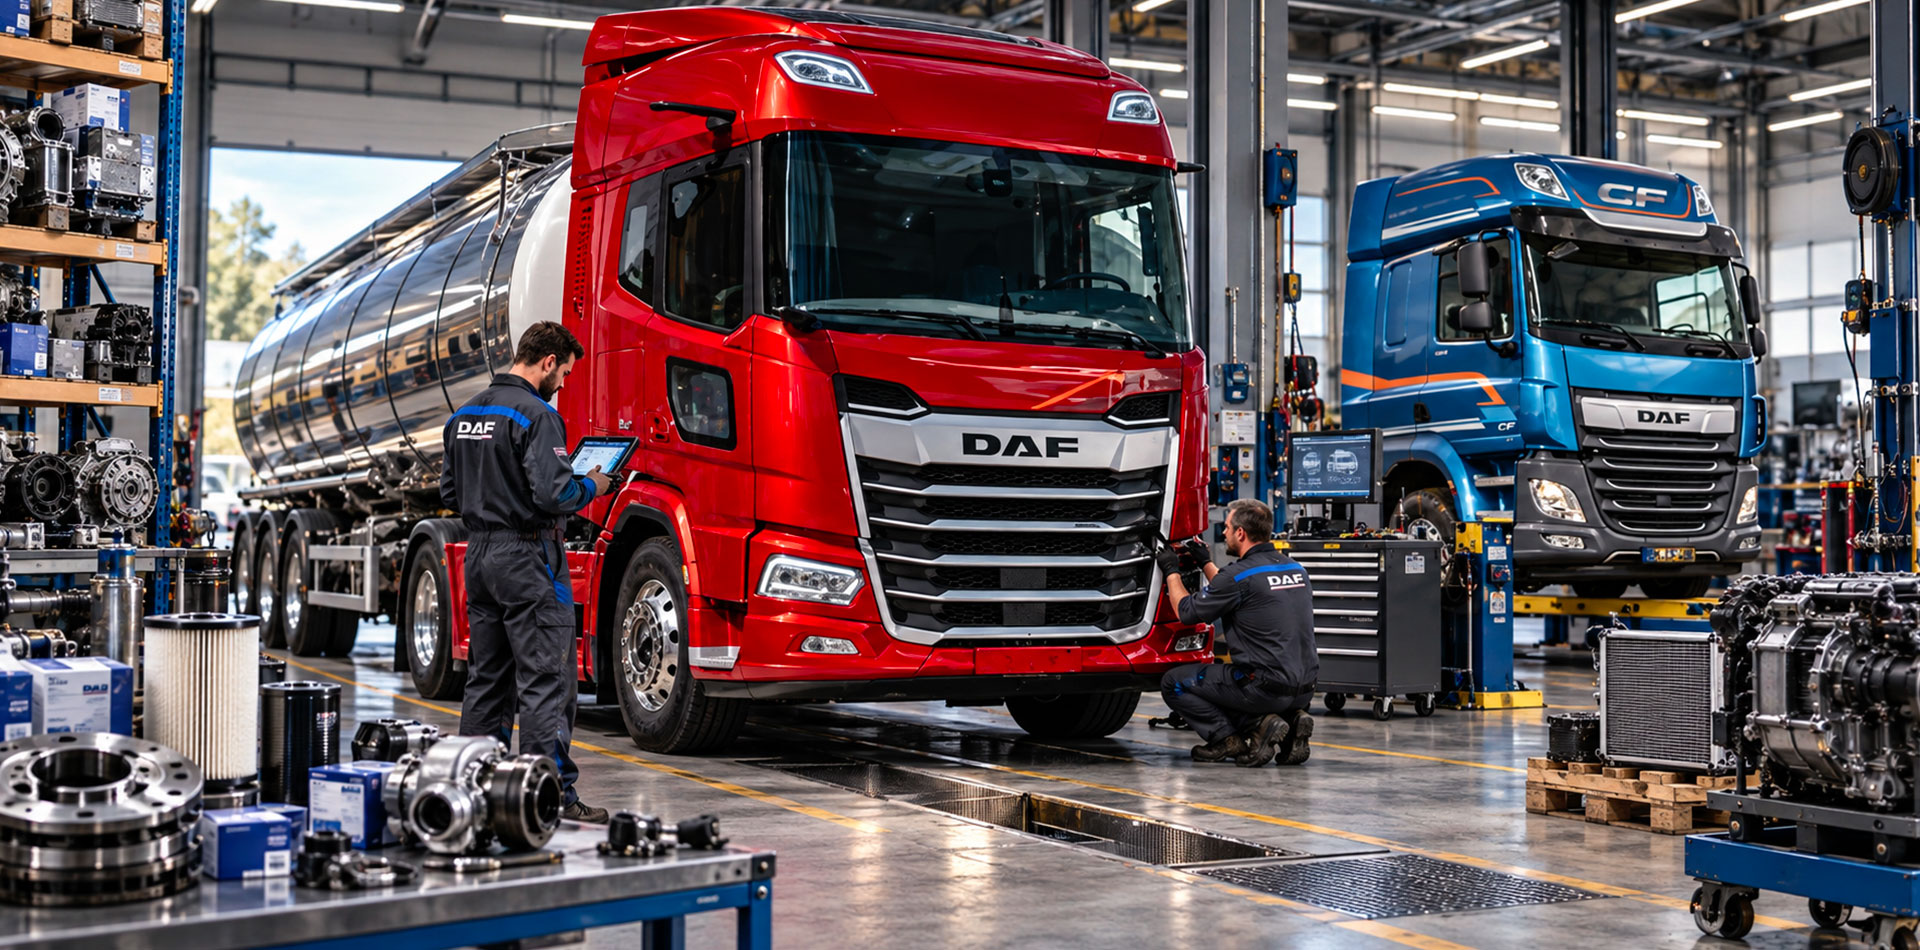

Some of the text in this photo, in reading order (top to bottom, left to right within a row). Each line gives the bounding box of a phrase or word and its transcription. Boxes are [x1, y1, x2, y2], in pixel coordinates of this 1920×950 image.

[1597, 182, 1668, 208] CF
[1637, 409, 1690, 425] DAF
[457, 421, 496, 434] DAF
[1497, 421, 1516, 431] CF
[962, 432, 1079, 458] DAF
[1267, 573, 1304, 586] DAF
